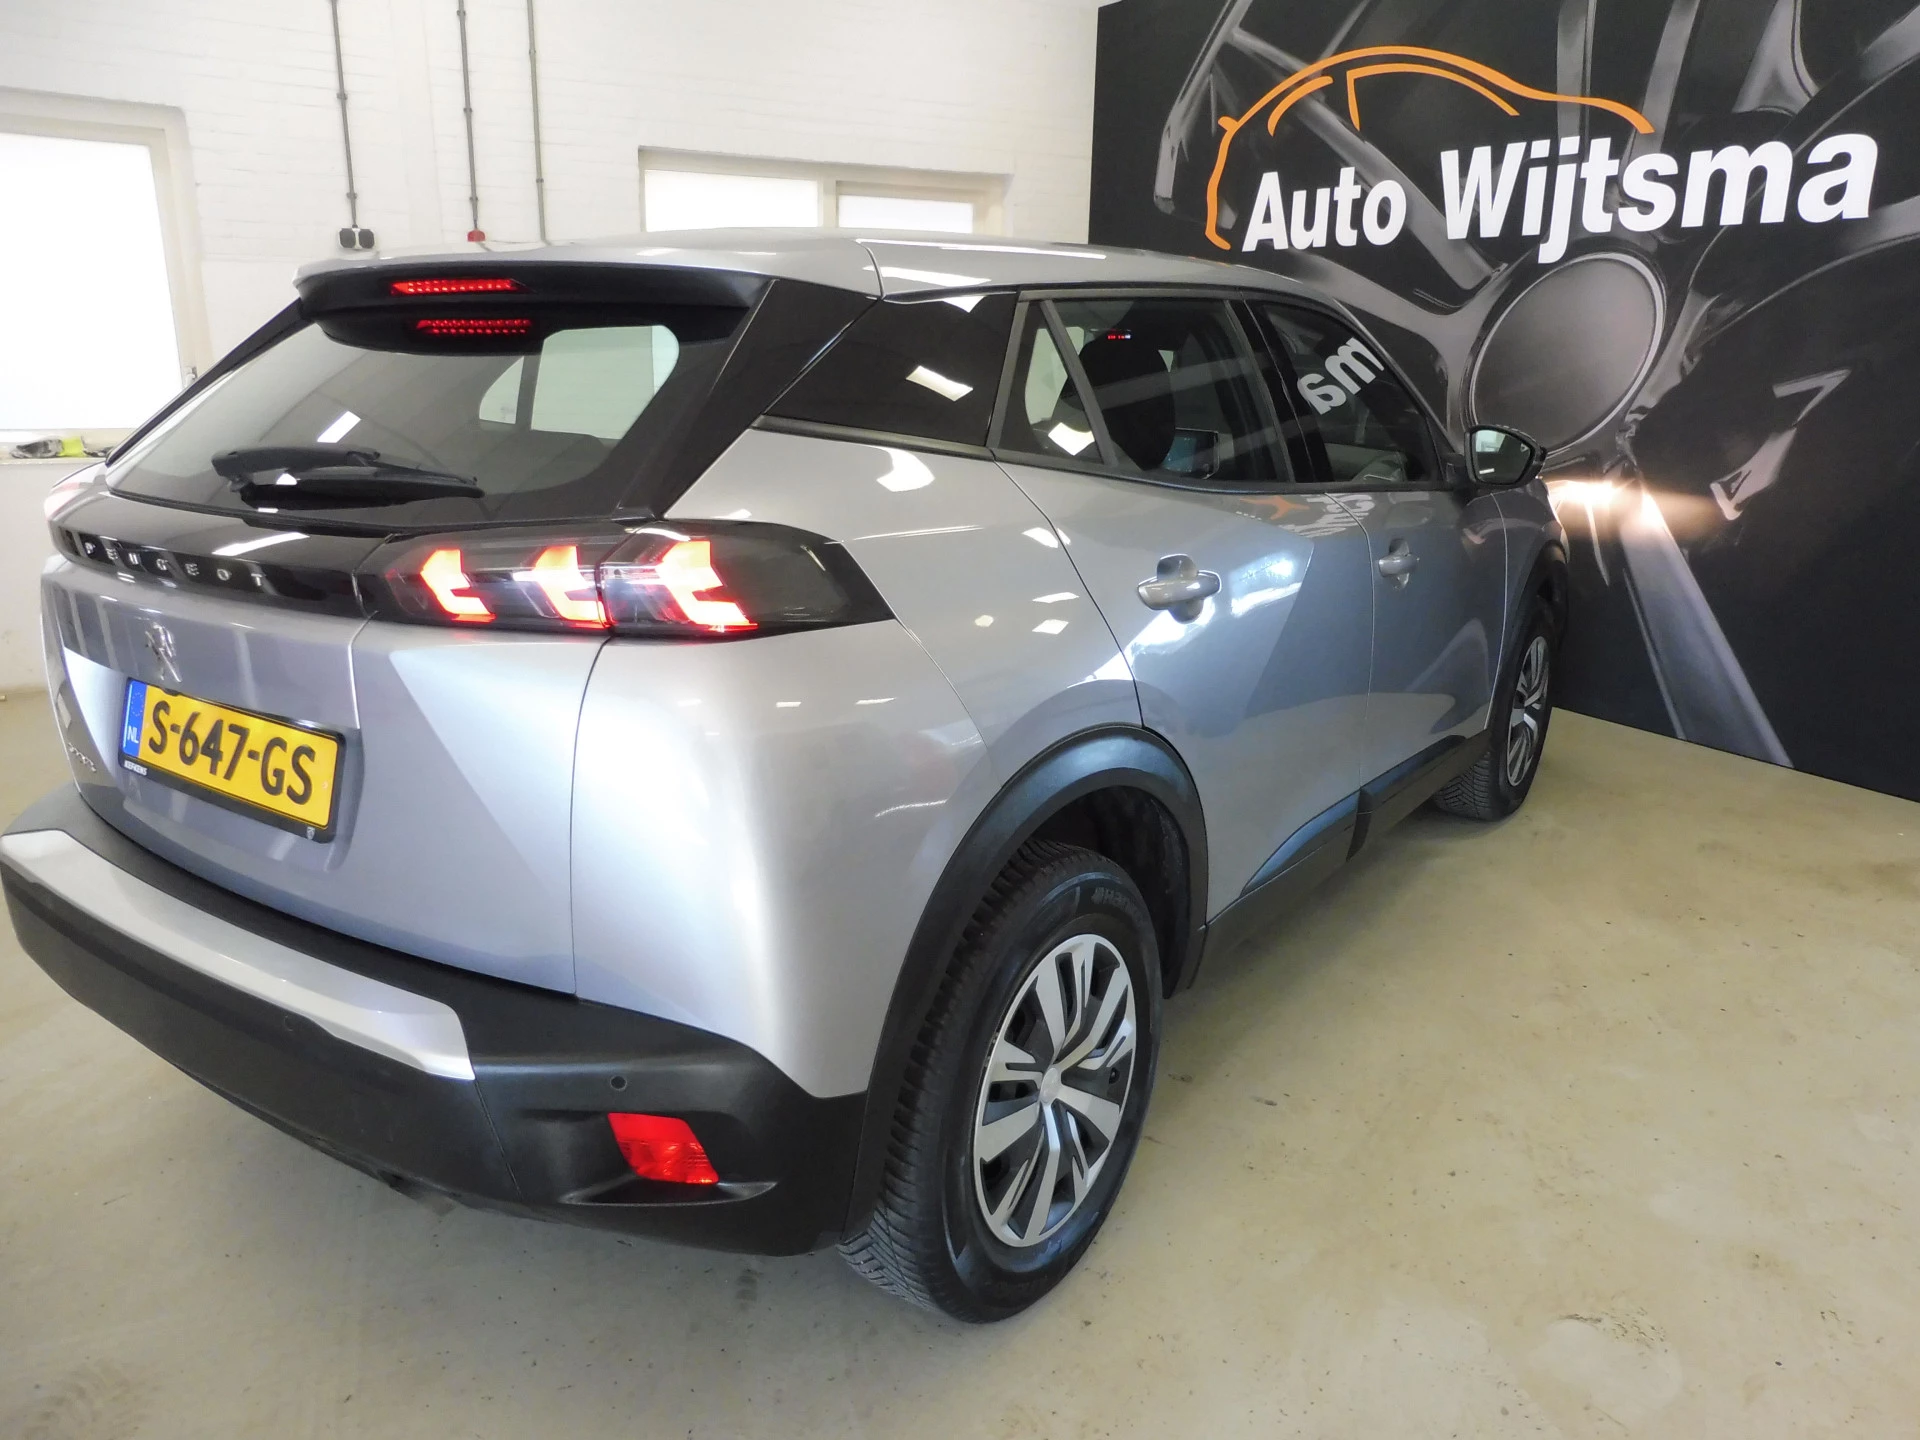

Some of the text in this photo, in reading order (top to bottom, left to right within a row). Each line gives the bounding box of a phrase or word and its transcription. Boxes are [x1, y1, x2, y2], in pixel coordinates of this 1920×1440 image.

[1242, 133, 1879, 264] Auto Wijtsma
[84, 541, 266, 587] PEUGEOT
[127, 725, 139, 744] NL
[148, 700, 316, 805] S-647-GS
